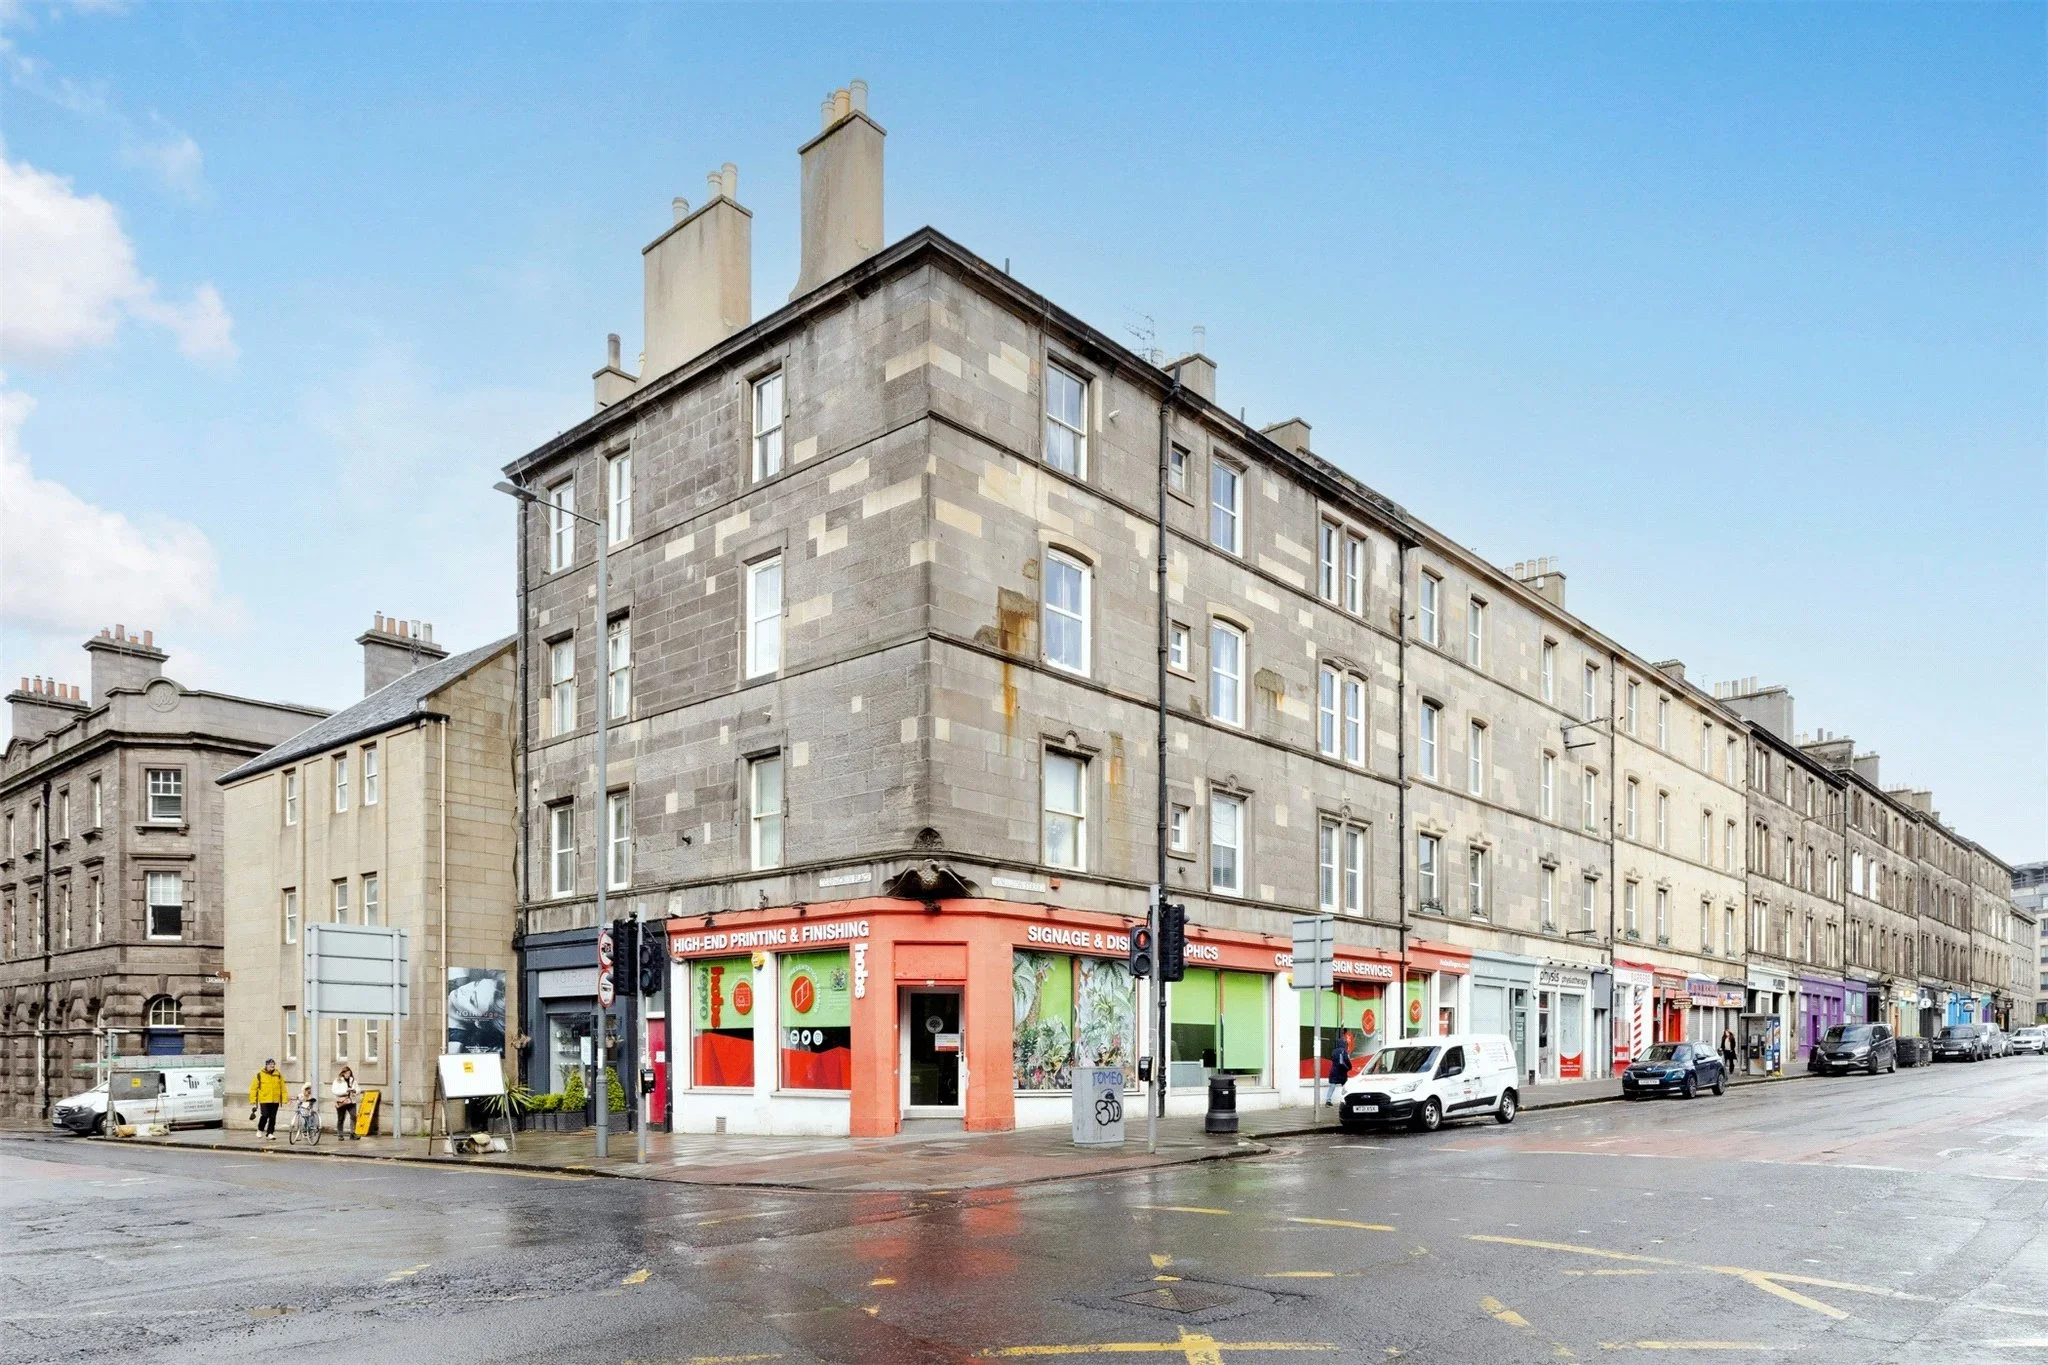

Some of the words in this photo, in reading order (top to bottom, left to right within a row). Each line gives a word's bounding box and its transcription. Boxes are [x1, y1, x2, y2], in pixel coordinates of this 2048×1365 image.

[673, 934, 727, 952] HIGH-END
[730, 928, 787, 948] PRINTING
[790, 927, 799, 944] &
[802, 920, 870, 942] FINISHING
[1028, 925, 1090, 948] SIGNAGE
[1093, 933, 1103, 949] &
[855, 943, 869, 999] hobs
[1274, 953, 1293, 967] CRE
[1333, 960, 1352, 974] SIGN
[1354, 962, 1393, 977] SERVICES
